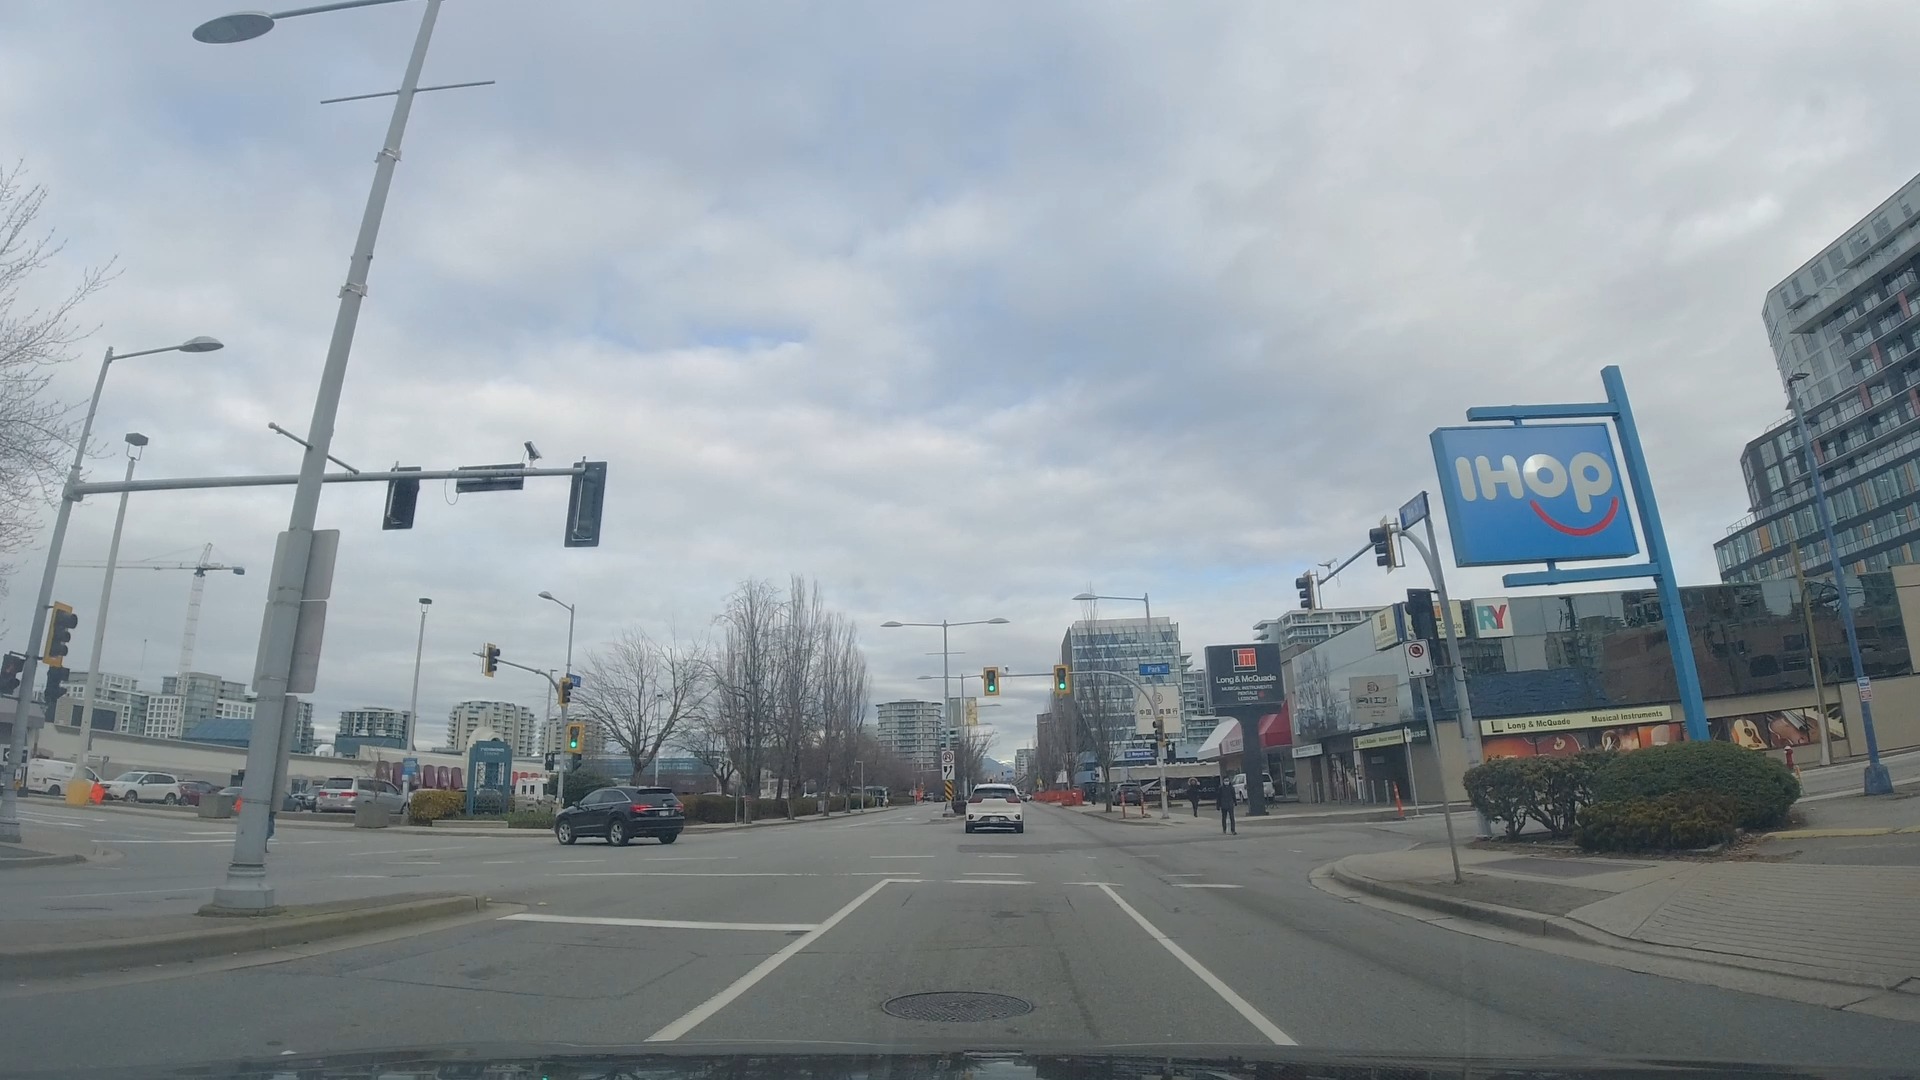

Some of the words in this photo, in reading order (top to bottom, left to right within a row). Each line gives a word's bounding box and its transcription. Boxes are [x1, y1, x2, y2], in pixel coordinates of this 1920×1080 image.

[1455, 452, 1612, 513] IHOP
[1476, 604, 1507, 631] RY
[1215, 675, 1234, 685] Long
[1235, 675, 1241, 683] &
[1241, 673, 1277, 683] McQuade
[1507, 722, 1526, 731] Long
[1536, 718, 1571, 728] McQuade
[1591, 713, 1619, 723] Musical
[1620, 710, 1663, 721] Instruments
